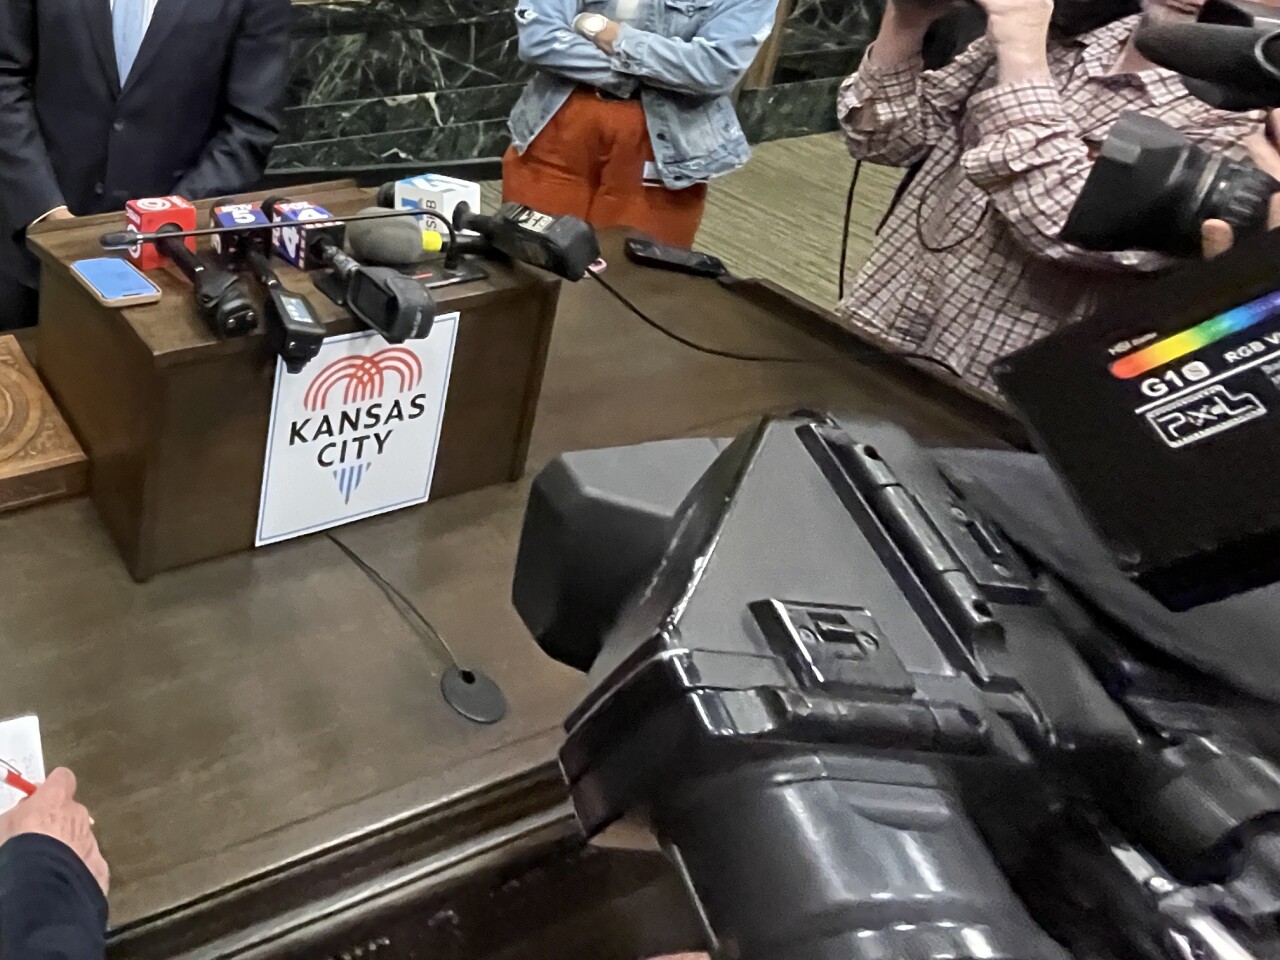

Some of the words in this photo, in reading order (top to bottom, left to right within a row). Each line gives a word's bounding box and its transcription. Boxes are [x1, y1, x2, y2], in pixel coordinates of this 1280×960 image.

[232, 209, 256, 224] 5
[1223, 341, 1267, 364] RGB
[288, 393, 427, 447] KANSAS
[317, 429, 394, 469] CITY
